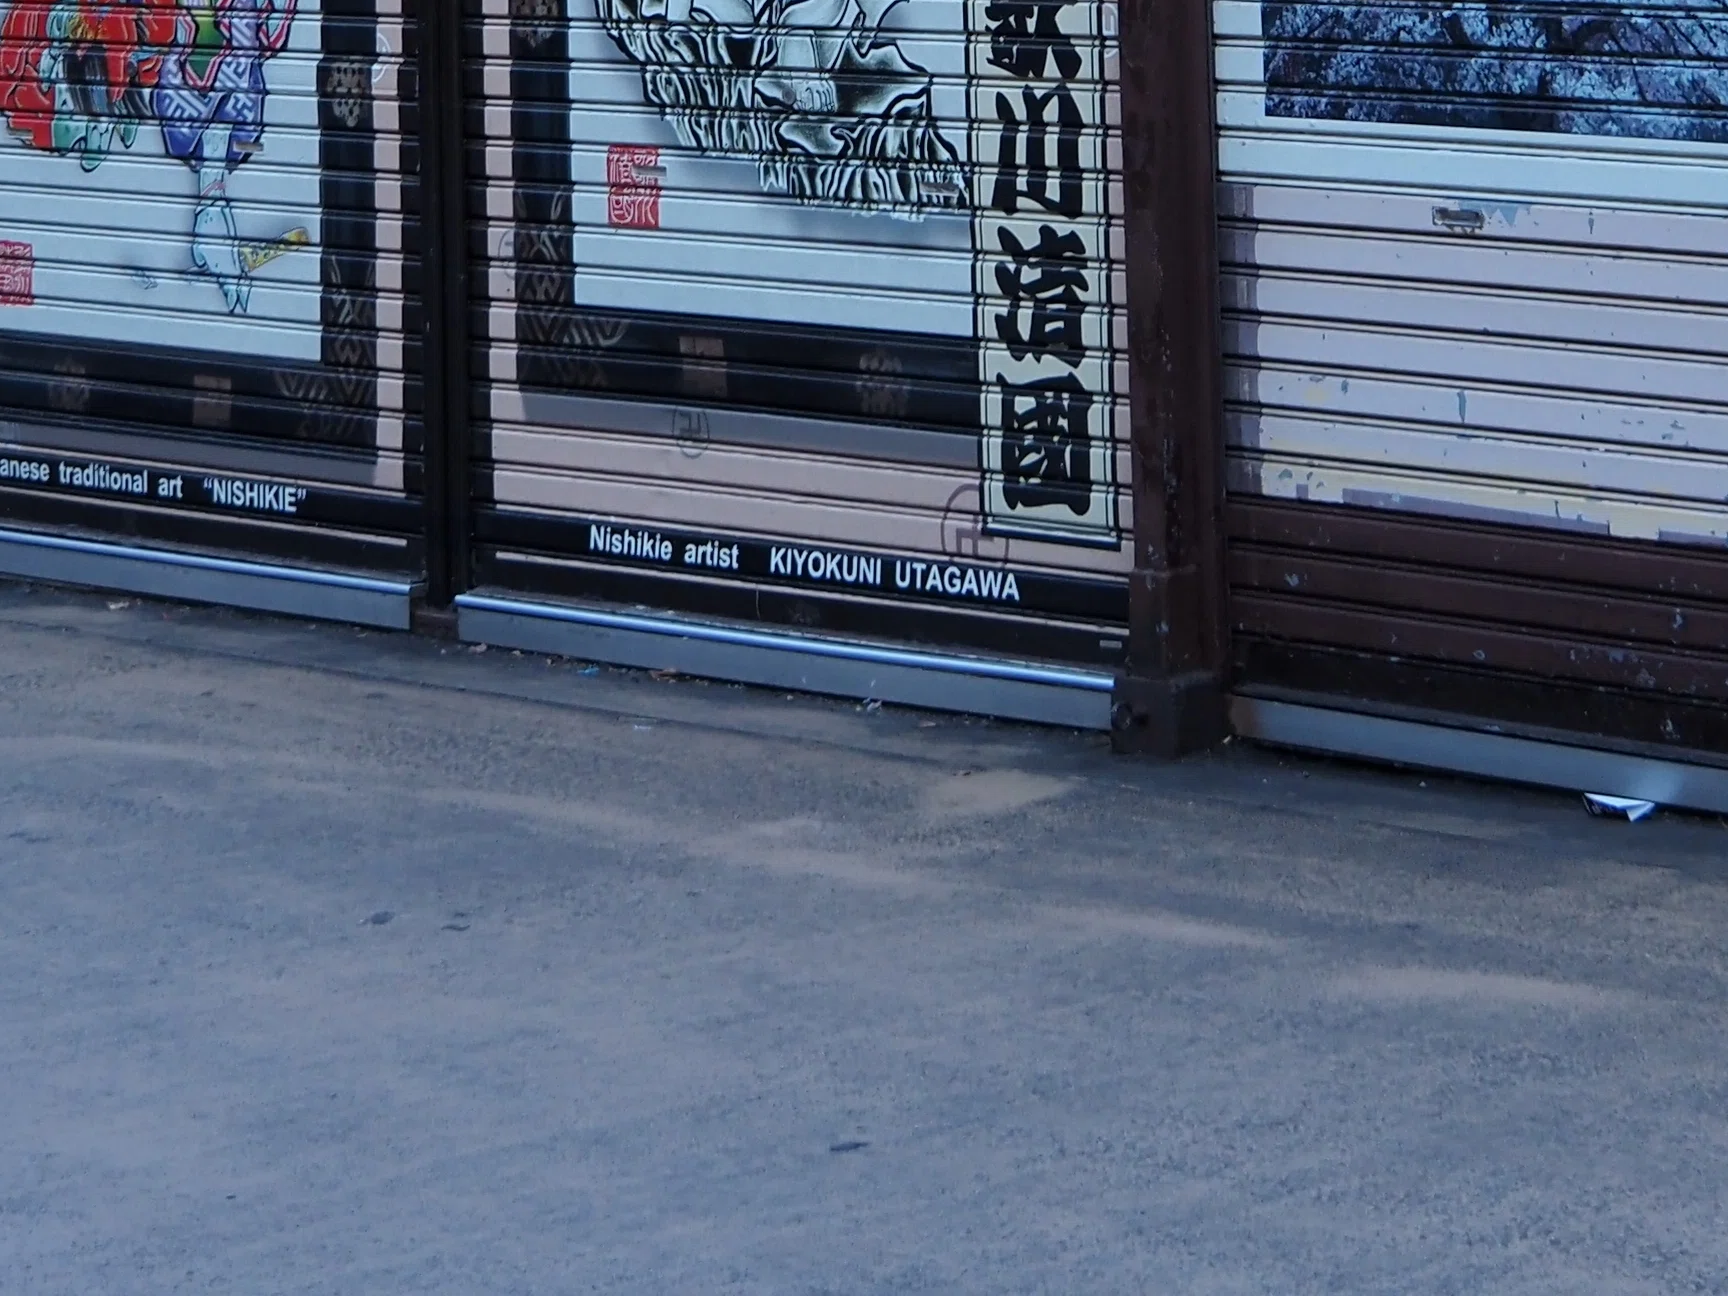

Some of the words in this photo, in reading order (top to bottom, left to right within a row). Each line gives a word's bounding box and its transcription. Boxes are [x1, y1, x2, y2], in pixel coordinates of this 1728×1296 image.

[58, 460, 150, 495] traditional
[157, 474, 184, 499] art
[589, 523, 673, 561] Nishikie
[683, 537, 740, 570] artist
[769, 545, 882, 586] KIYOKUNI
[894, 560, 1021, 602] UTAGAWA
